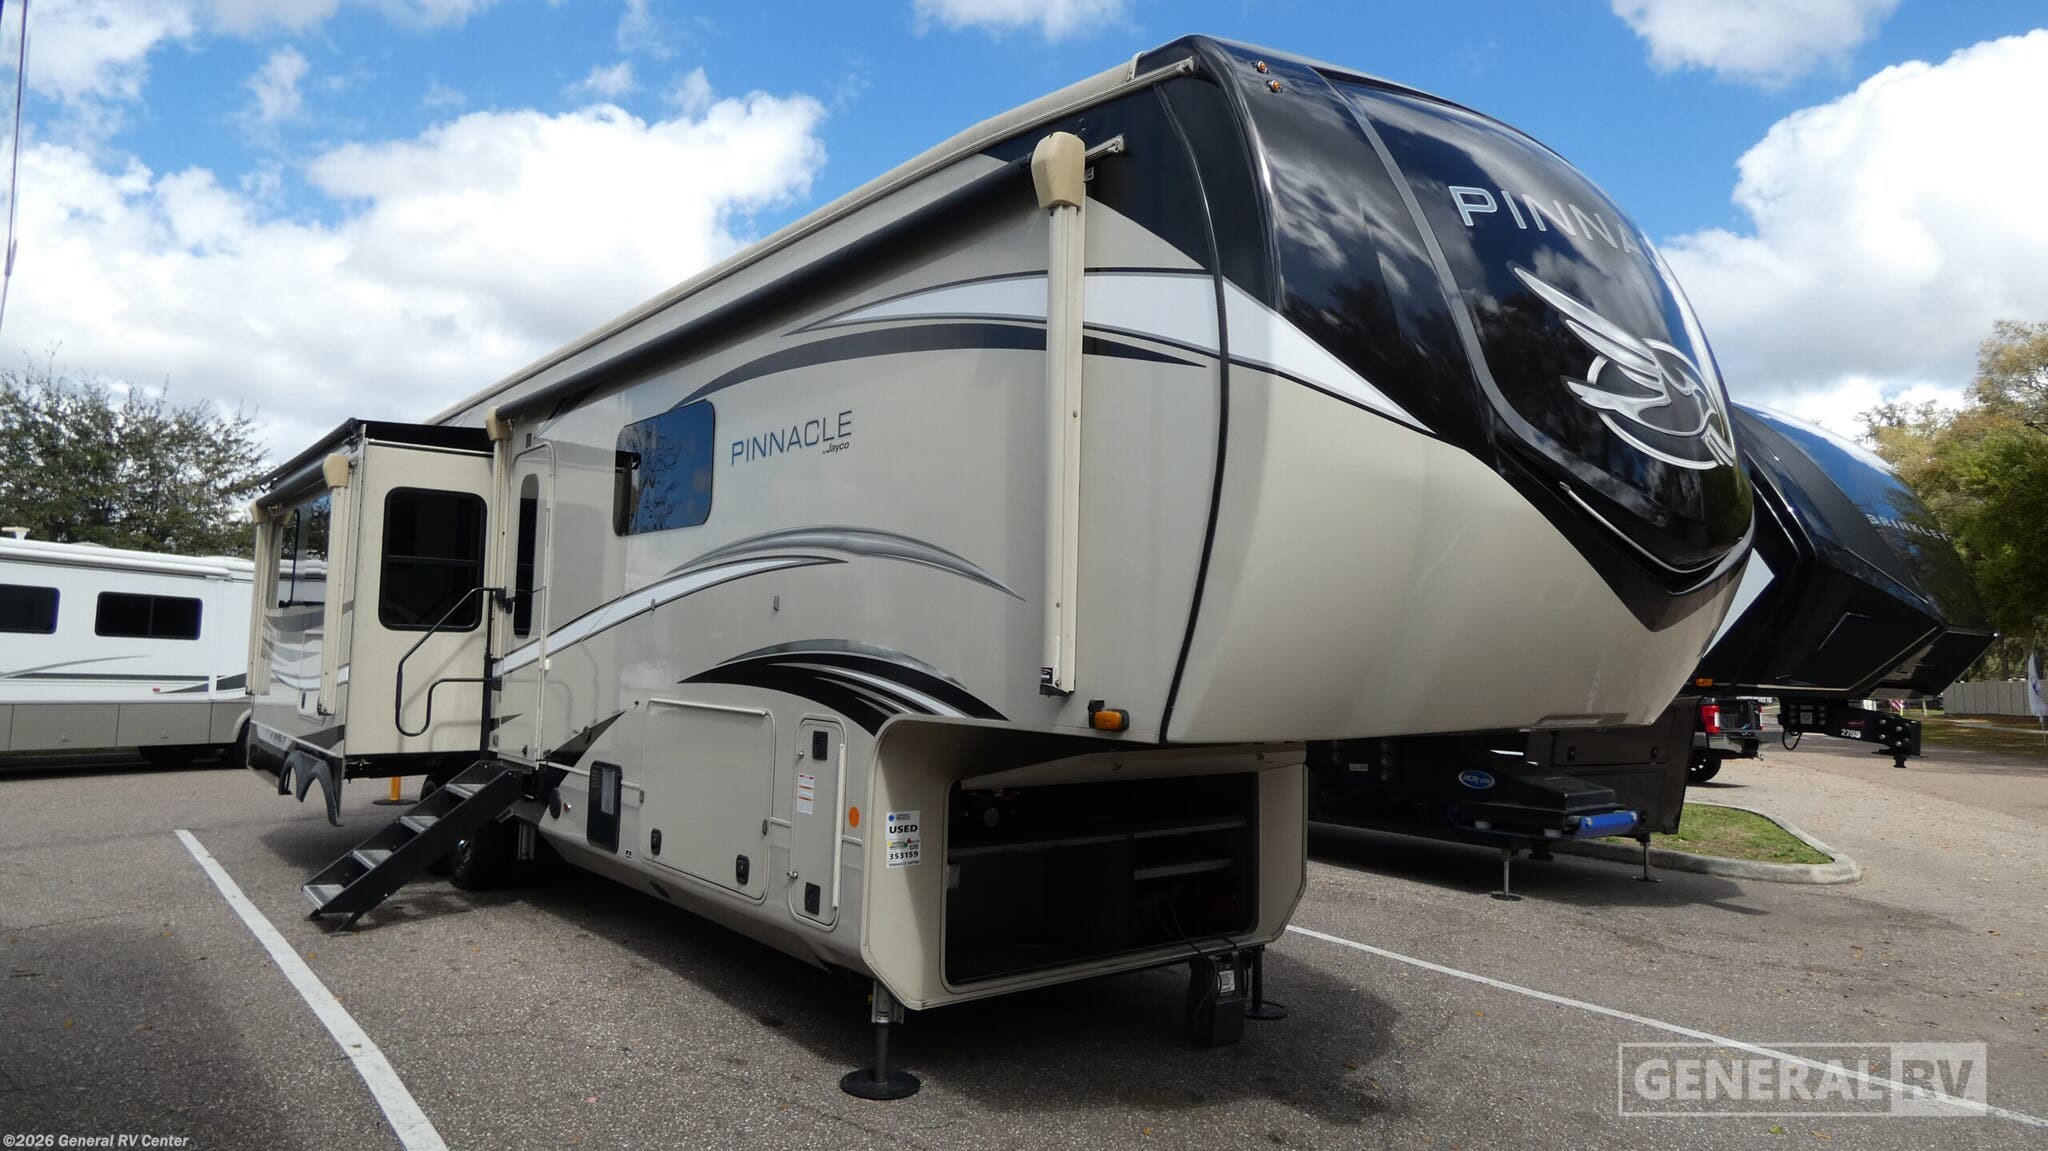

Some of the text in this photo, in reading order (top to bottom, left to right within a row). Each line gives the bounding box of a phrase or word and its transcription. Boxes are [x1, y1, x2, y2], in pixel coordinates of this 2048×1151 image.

[731, 409, 852, 467] PINNACLE
[826, 441, 850, 454] Jayco
[1866, 513, 1952, 542] BRINKLEY
[889, 824, 918, 834] USED
[889, 850, 919, 860] 353159
